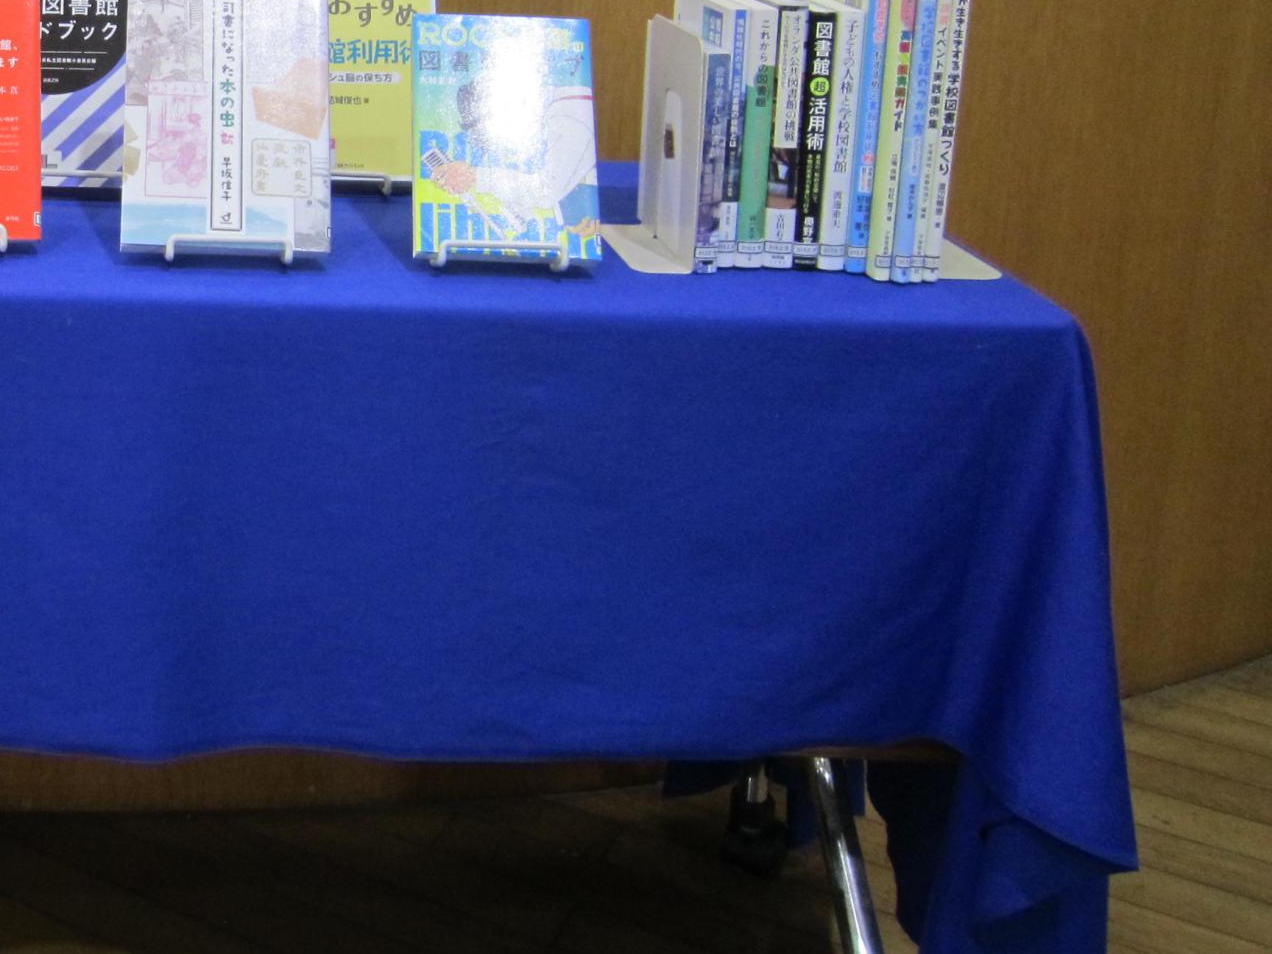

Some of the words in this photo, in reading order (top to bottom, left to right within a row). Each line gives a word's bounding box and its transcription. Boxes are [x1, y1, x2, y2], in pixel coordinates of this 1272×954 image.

[219, 1, 236, 128] 司書になった本の虫
[755, 19, 770, 107] これからの図書館
[783, 14, 801, 142] オランダ公共図書館の挑戦
[806, 21, 833, 151] 図書館超活用術
[833, 19, 860, 174] 子どもの人権と学校図書館
